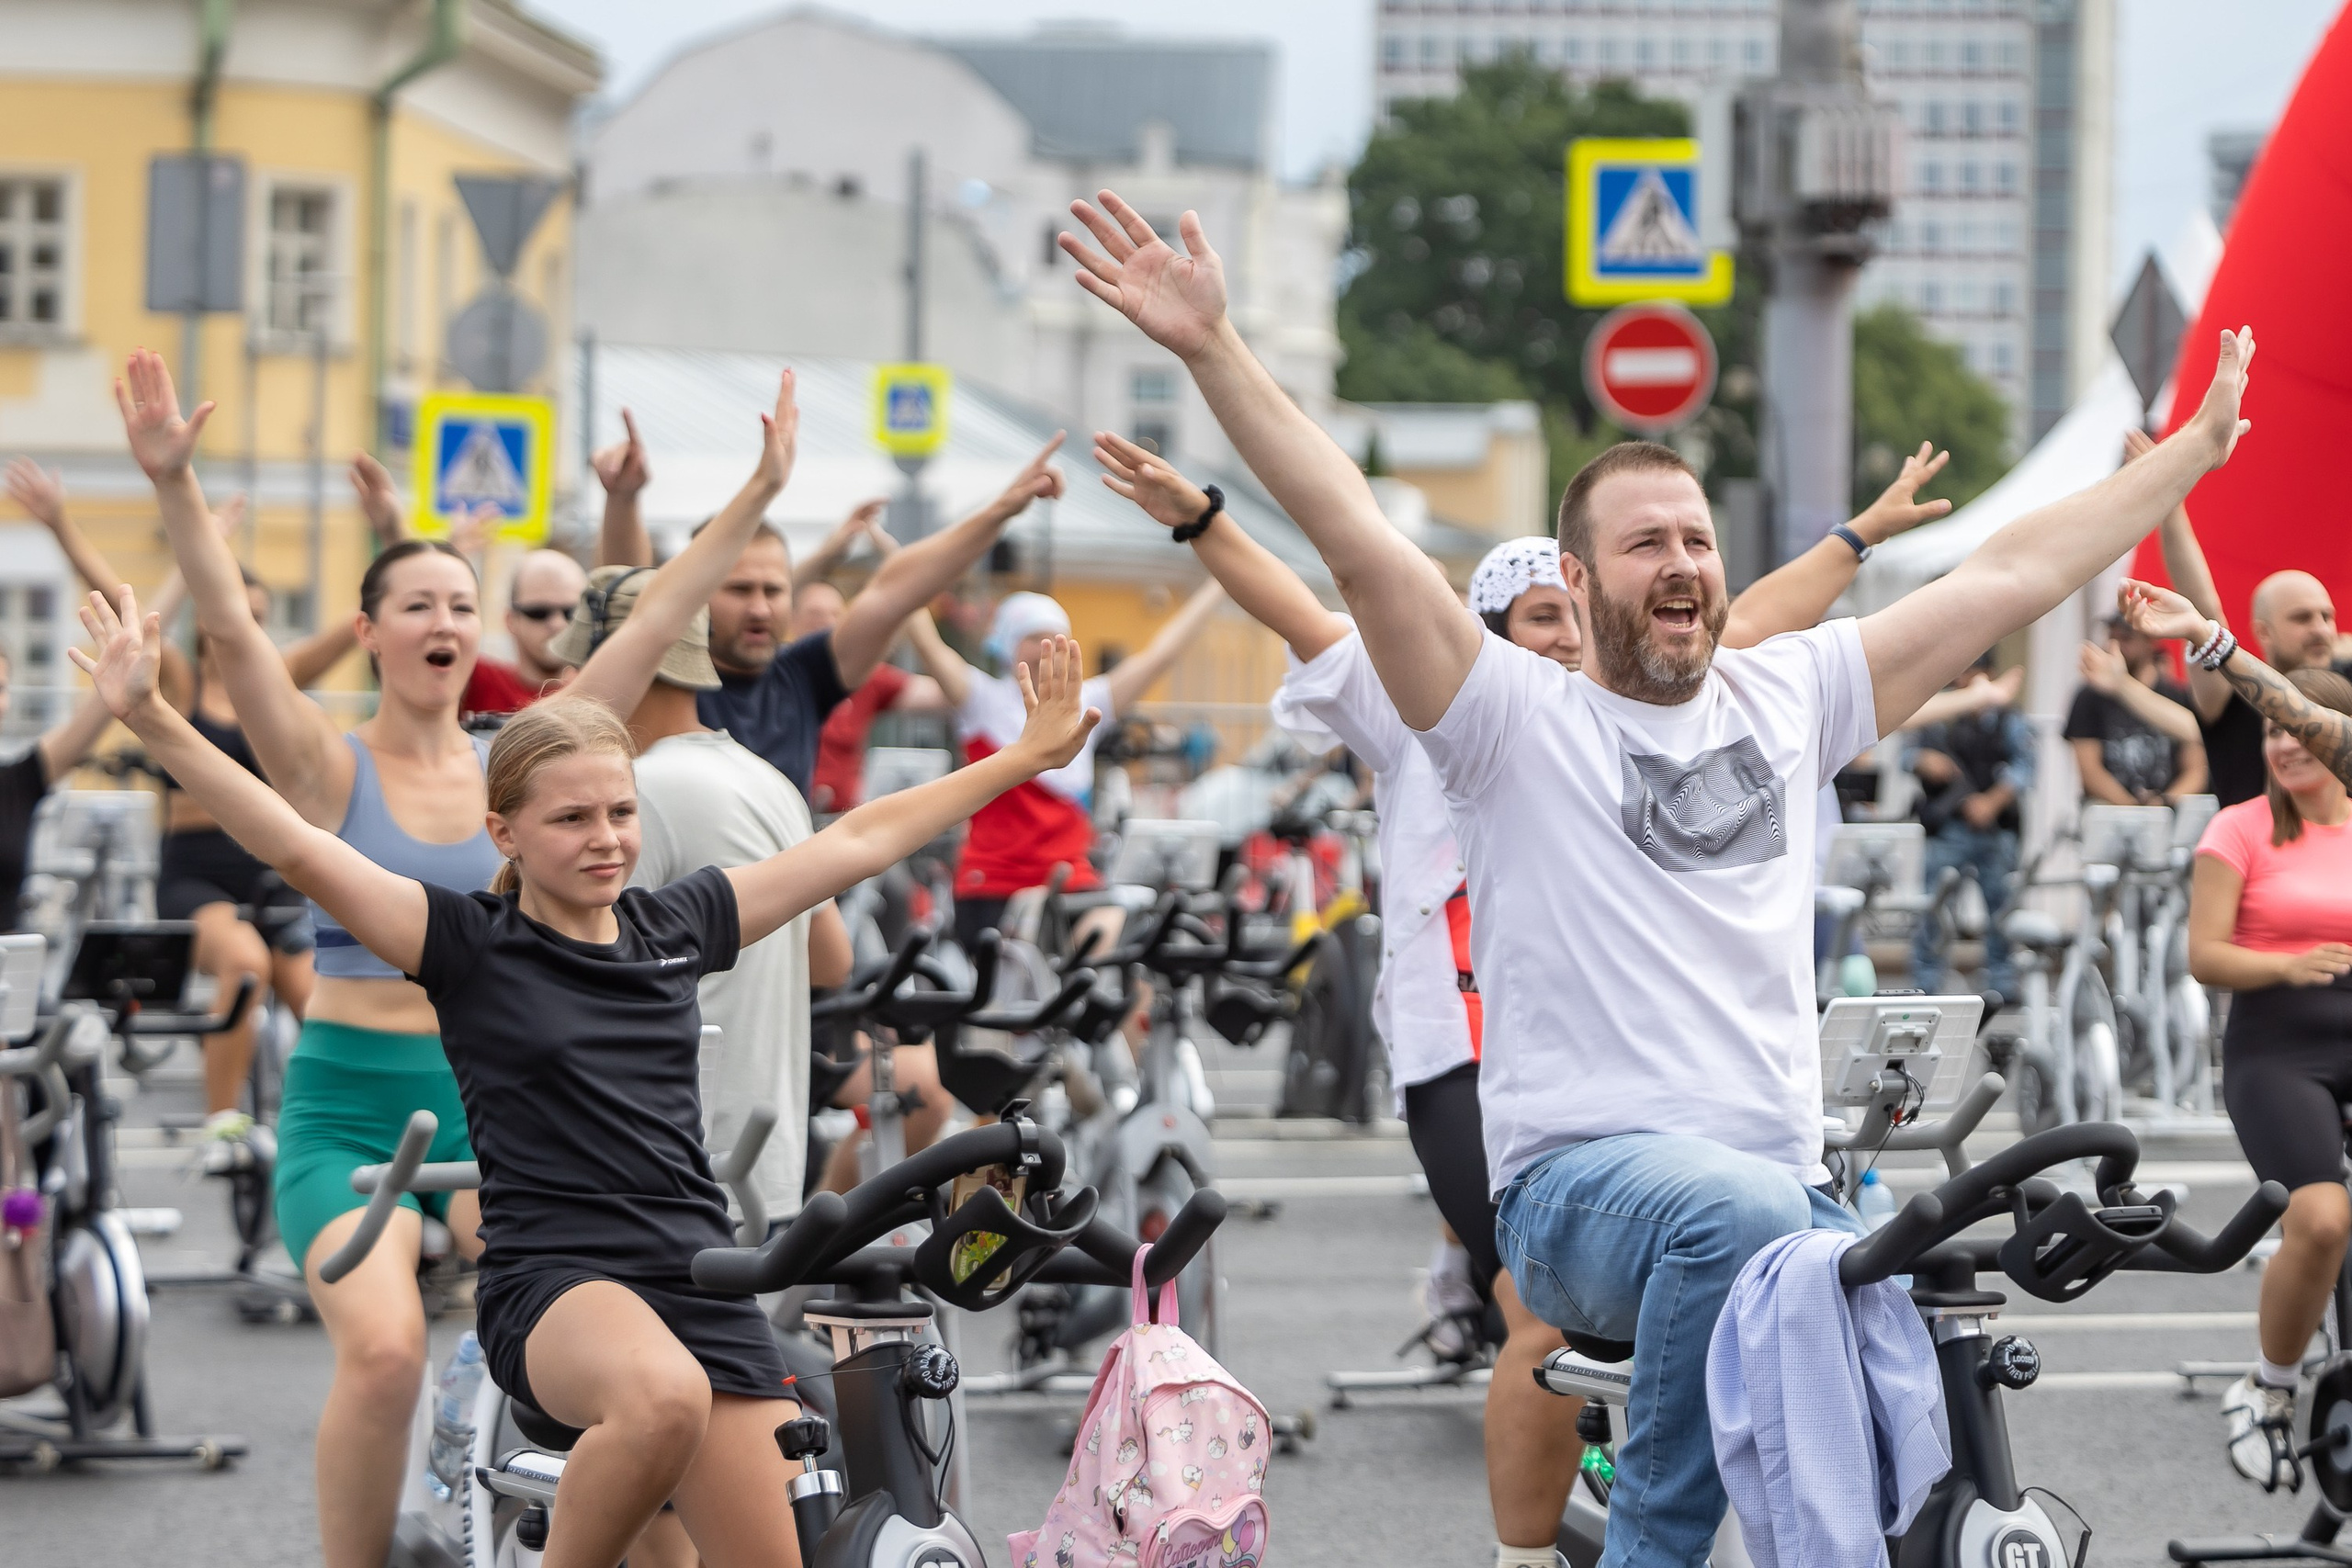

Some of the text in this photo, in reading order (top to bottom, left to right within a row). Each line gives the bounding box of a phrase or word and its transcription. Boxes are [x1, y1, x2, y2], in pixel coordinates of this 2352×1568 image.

[922, 1370, 933, 1382] TO
[2007, 1364, 2023, 1380] THEN
[942, 1373, 956, 1390] THEN
[2006, 1542, 2041, 1568] GT
